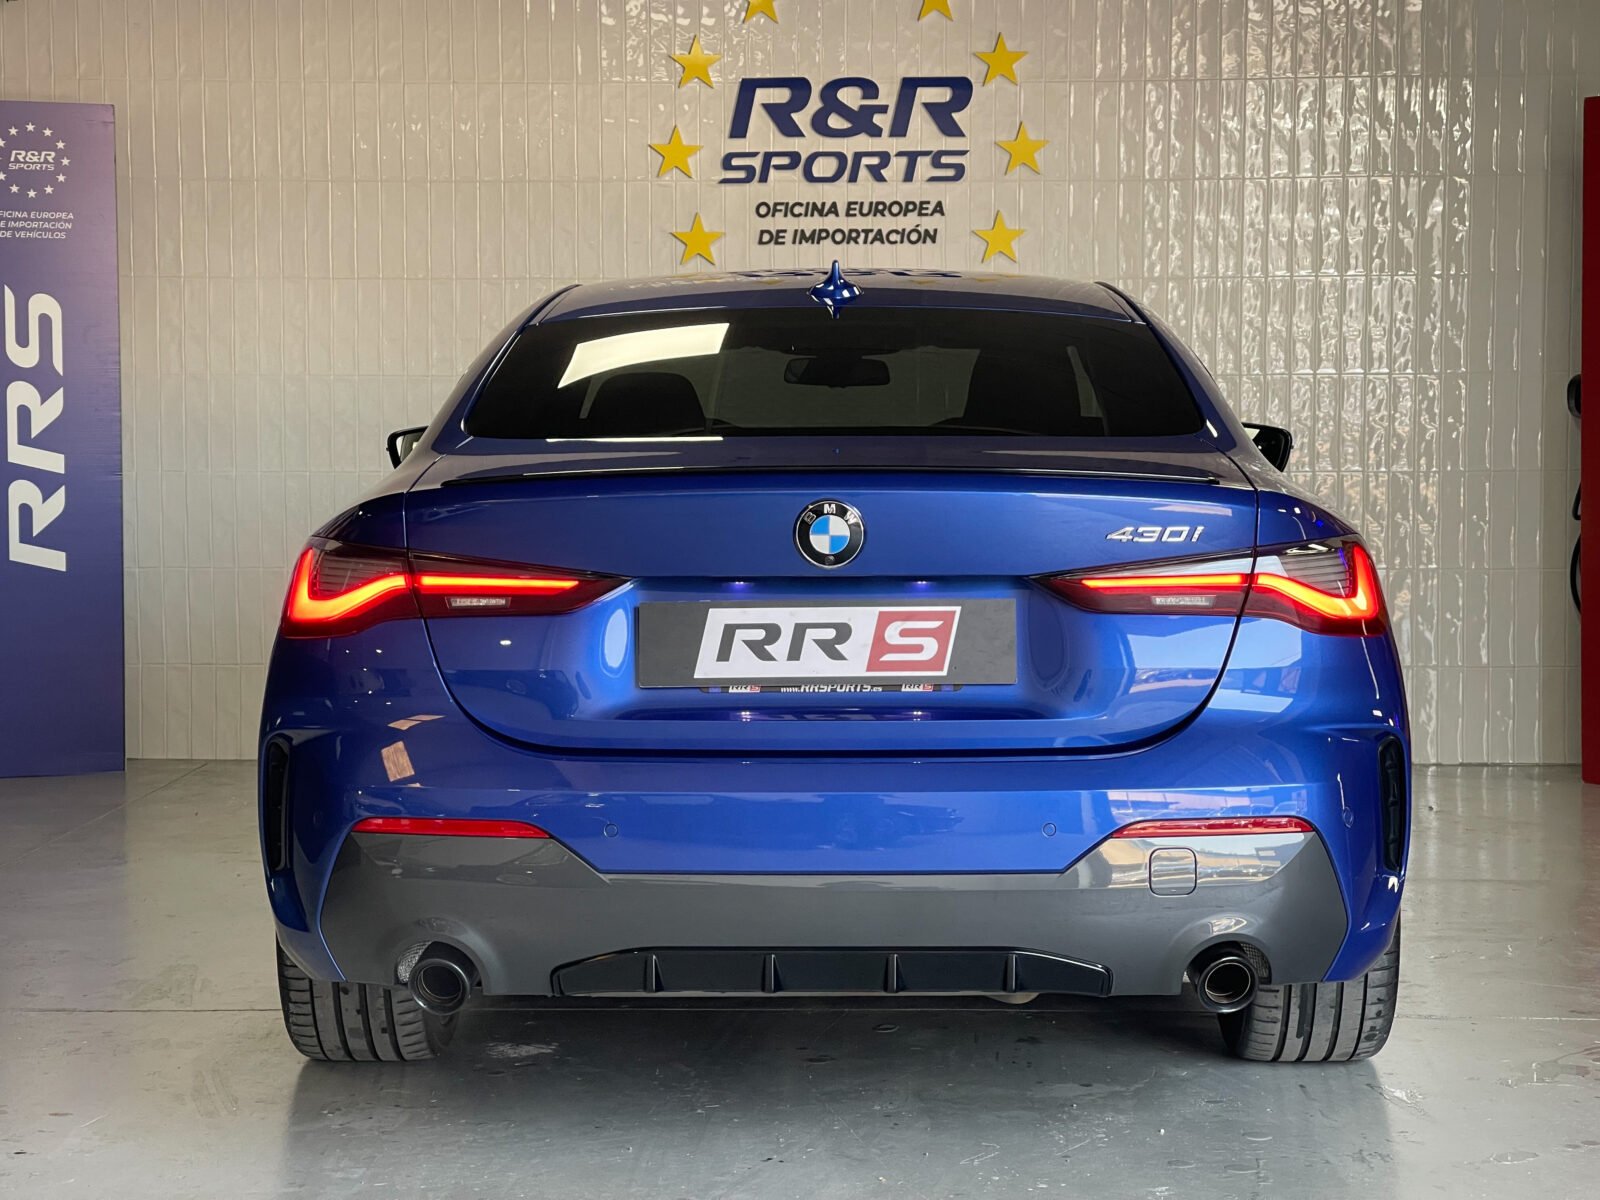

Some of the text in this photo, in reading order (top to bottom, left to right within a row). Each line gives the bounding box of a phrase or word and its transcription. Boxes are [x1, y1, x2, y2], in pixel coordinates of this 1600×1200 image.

[728, 76, 973, 139] R&R
[8, 162, 55, 171] SPORTS
[10, 150, 56, 163] R&R
[718, 150, 970, 184] SPORTS
[0, 210, 74, 220] FICINA EUROPEA
[755, 200, 946, 218] OFICINA EUROPEA
[0, 229, 67, 239] DE VEHÍCULOS
[8, 220, 73, 230] IMPORTACIÓN
[757, 224, 938, 246] DE IMPORTACIÓN
[4, 284, 67, 572] RRS
[803, 503, 861, 525] BMW
[715, 620, 945, 663] RRS
